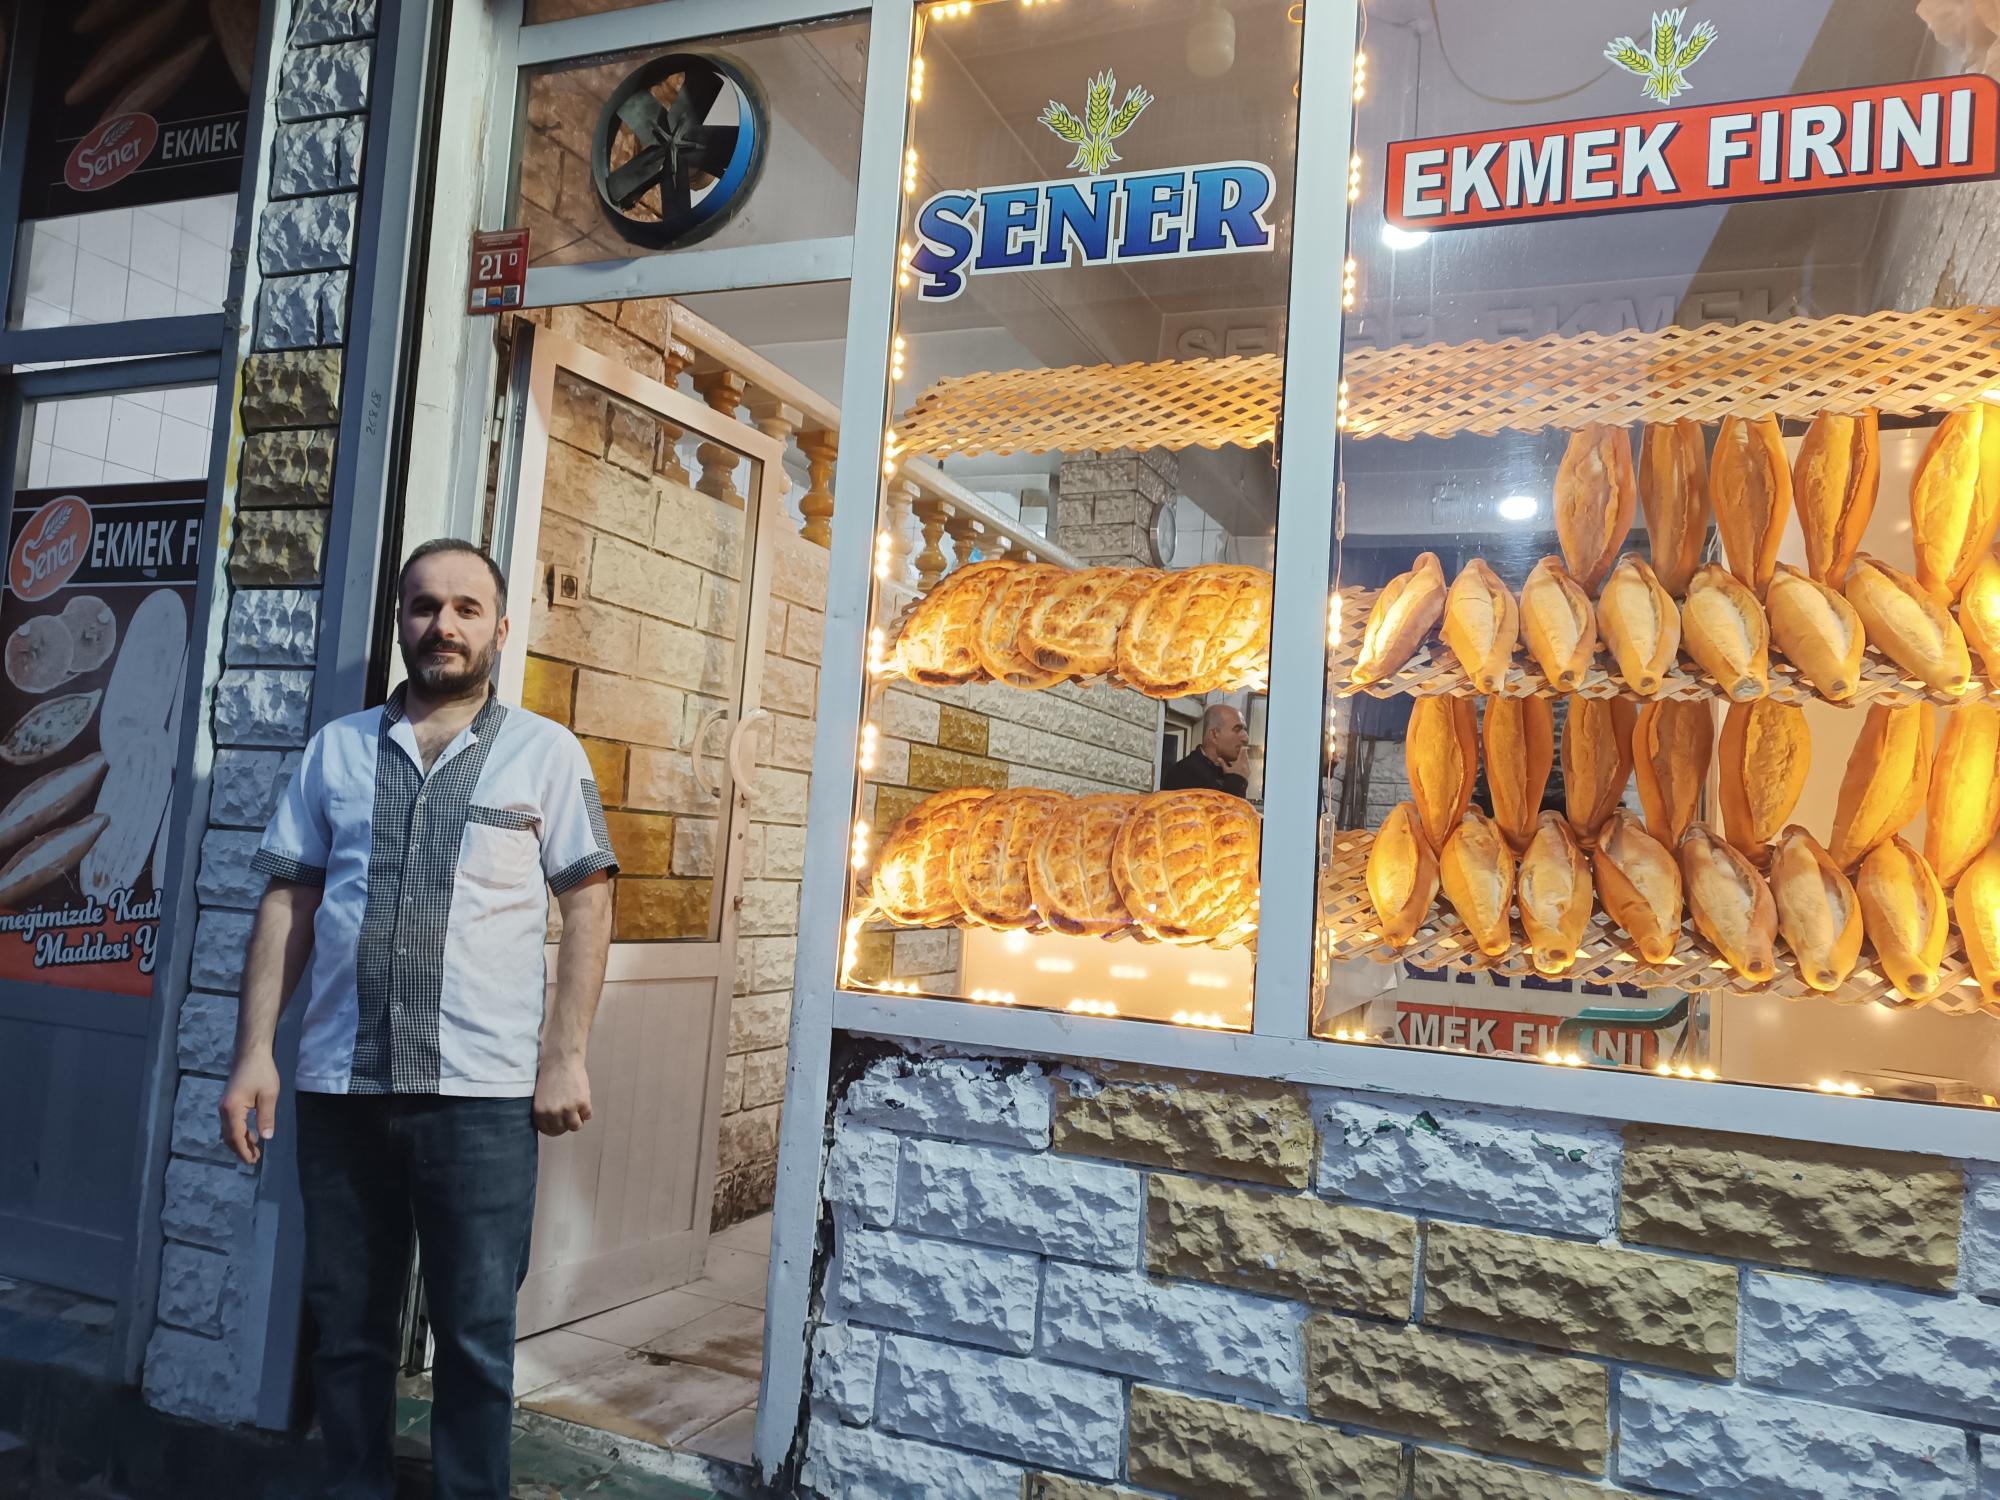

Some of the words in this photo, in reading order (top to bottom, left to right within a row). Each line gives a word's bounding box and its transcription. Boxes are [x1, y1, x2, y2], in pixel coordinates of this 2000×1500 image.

[162, 121, 240, 160] EKMEK
[1402, 120, 1680, 217] EKMEK
[1706, 89, 1976, 188] FIRINI
[910, 162, 1275, 299] ŞENER
[479, 254, 503, 280] 21
[509, 252, 518, 266] D
[90, 519, 177, 568] EKMEK
[34, 931, 130, 968] Maddesi
